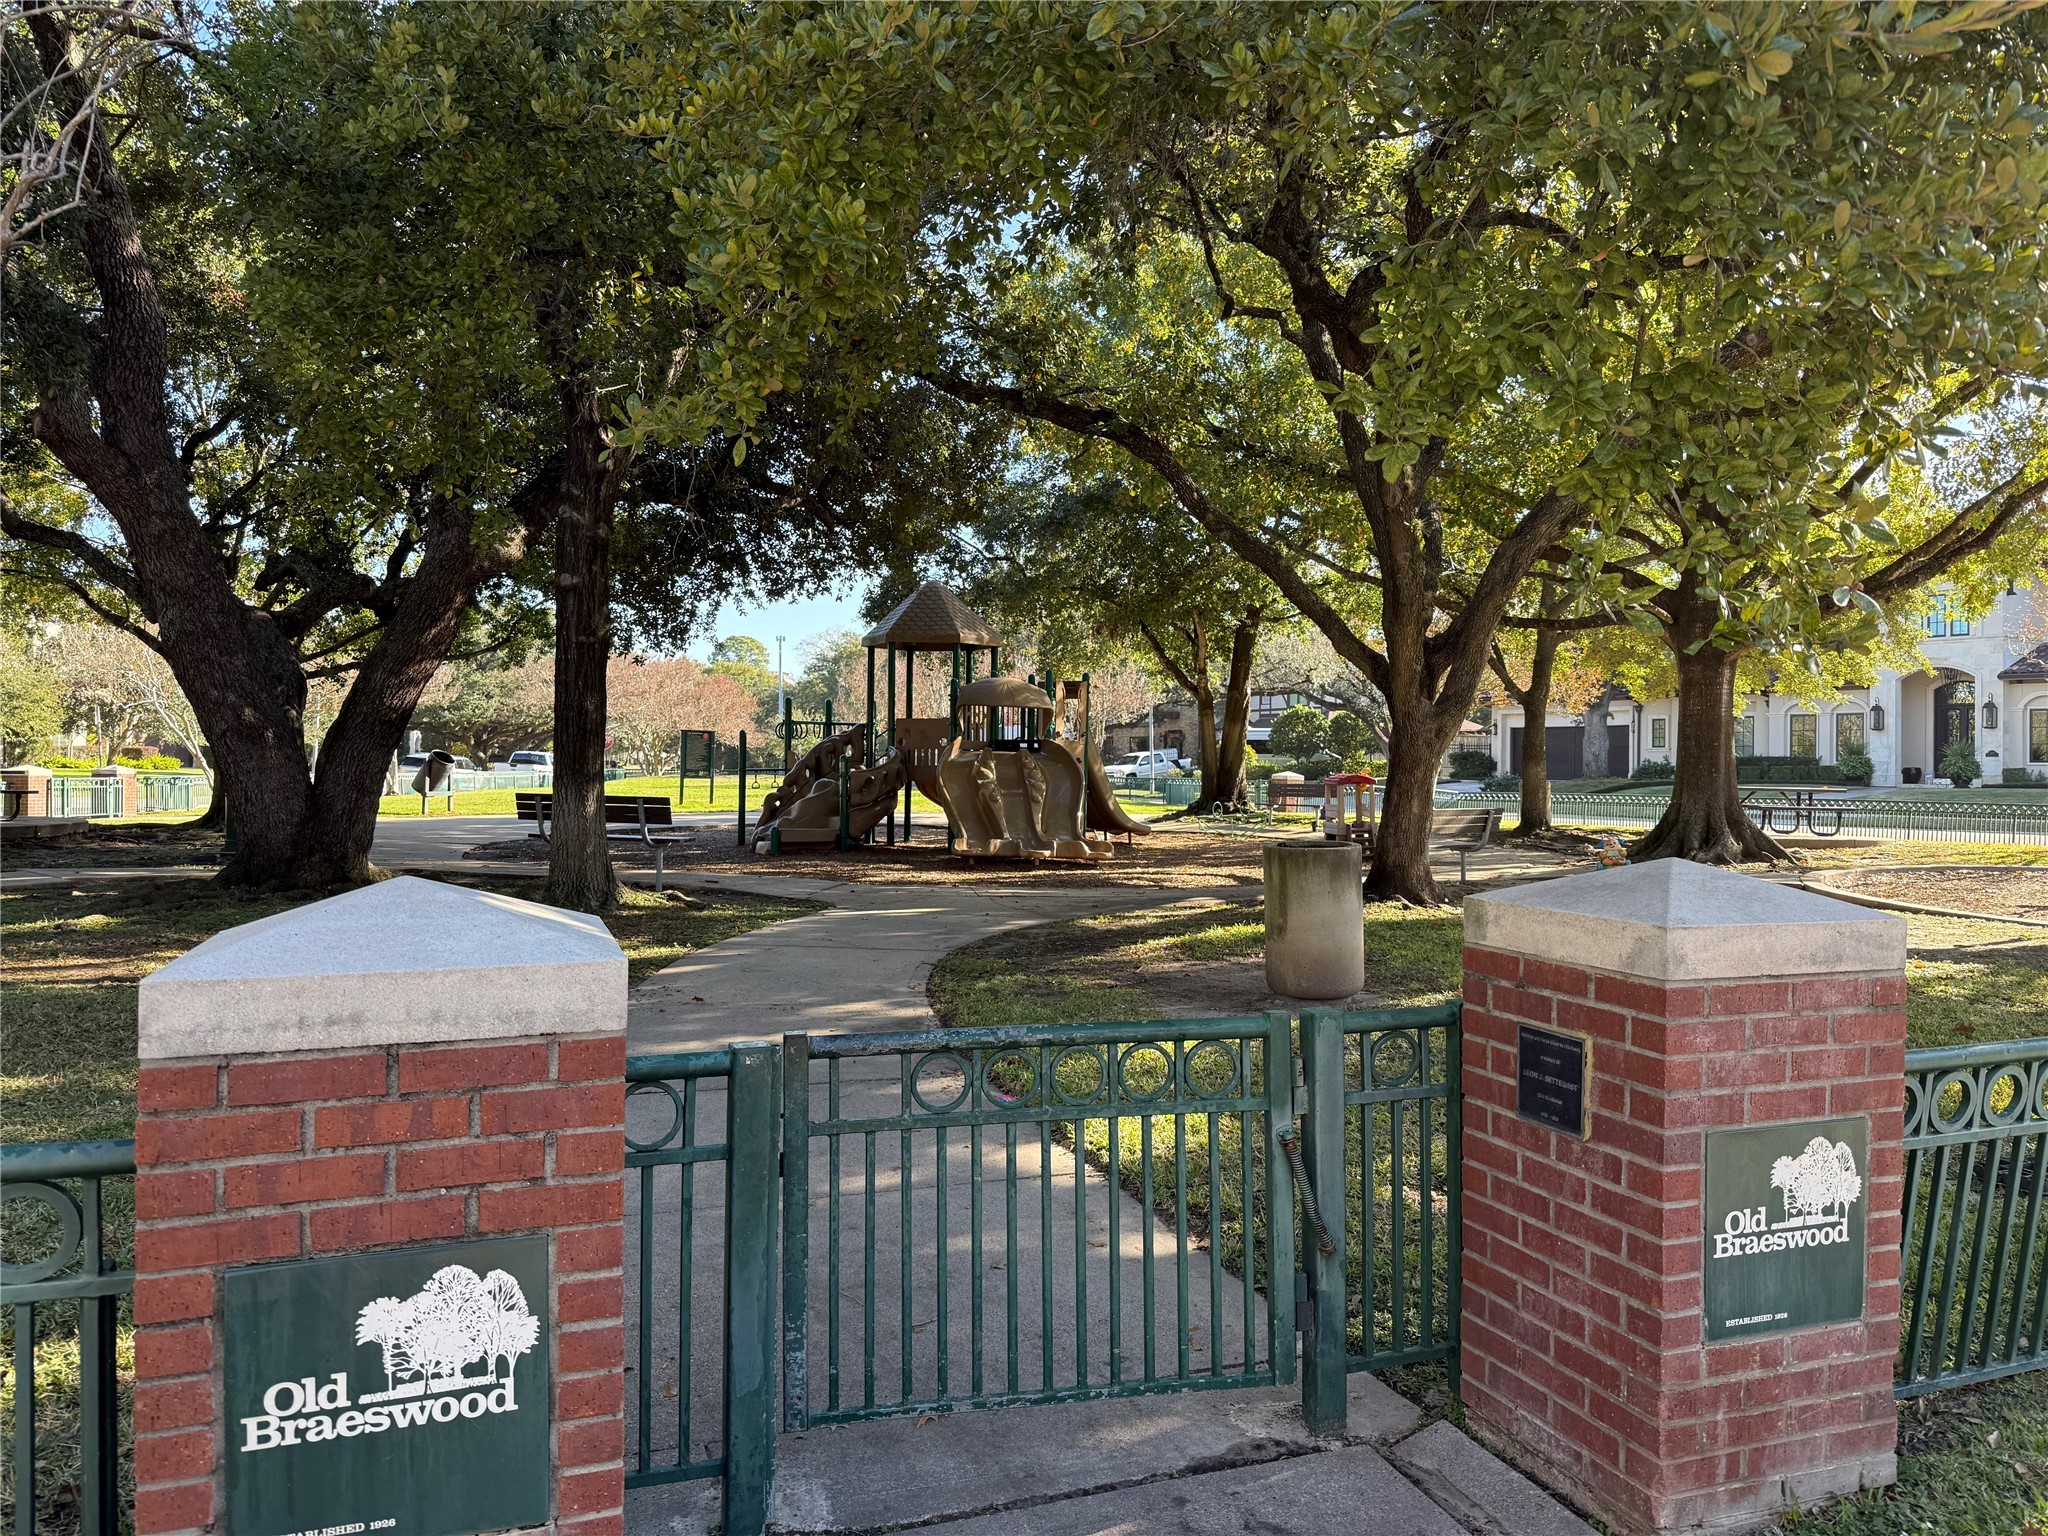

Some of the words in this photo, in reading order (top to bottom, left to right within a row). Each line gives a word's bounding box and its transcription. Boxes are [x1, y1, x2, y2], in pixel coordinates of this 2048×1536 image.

[1523, 1068, 1539, 1079] LEON
[1725, 1206, 1767, 1236] Old
[1713, 1217, 1849, 1259] Braeswood
[1725, 1314, 1773, 1328] ESTABLISHED
[1774, 1312, 1788, 1320] 1926
[263, 1372, 351, 1417] Old
[240, 1377, 519, 1452] Braeswood
[281, 1522, 365, 1536] BLISHED
[369, 1518, 397, 1530] 1926
